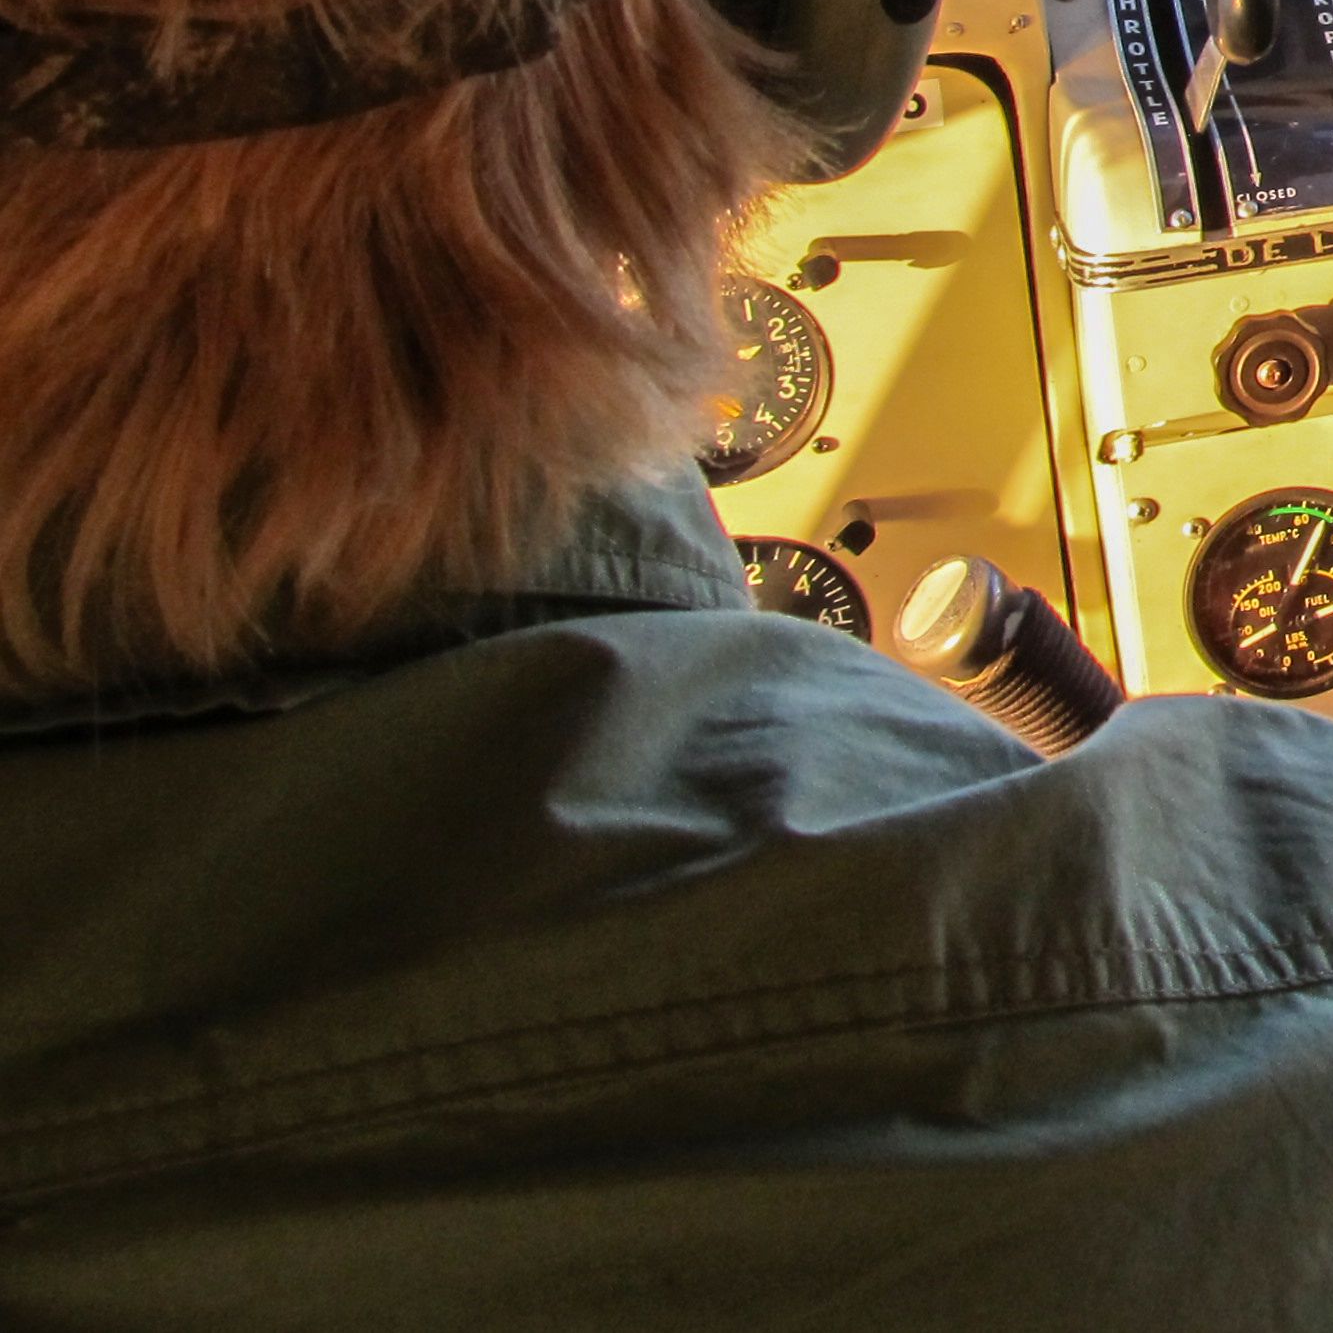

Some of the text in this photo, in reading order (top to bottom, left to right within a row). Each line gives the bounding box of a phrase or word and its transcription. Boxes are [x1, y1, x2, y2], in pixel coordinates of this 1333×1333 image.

[768, 317, 787, 341] 2
[777, 374, 796, 399] 3
[754, 402, 774, 424] 4
[716, 422, 734, 446] 5
[1294, 514, 1309, 526] 60
[1259, 532, 1288, 546] TEMP.
[744, 563, 764, 585] 2
[793, 574, 811, 596] 4
[1258, 581, 1281, 595] 200
[1240, 598, 1260, 612] 150
[1305, 595, 1330, 607] FUEL
[1259, 606, 1277, 618] OIL
[1285, 633, 1308, 645] LBS.
[1283, 656, 1291, 667] 0
[1307, 651, 1315, 661] 0
